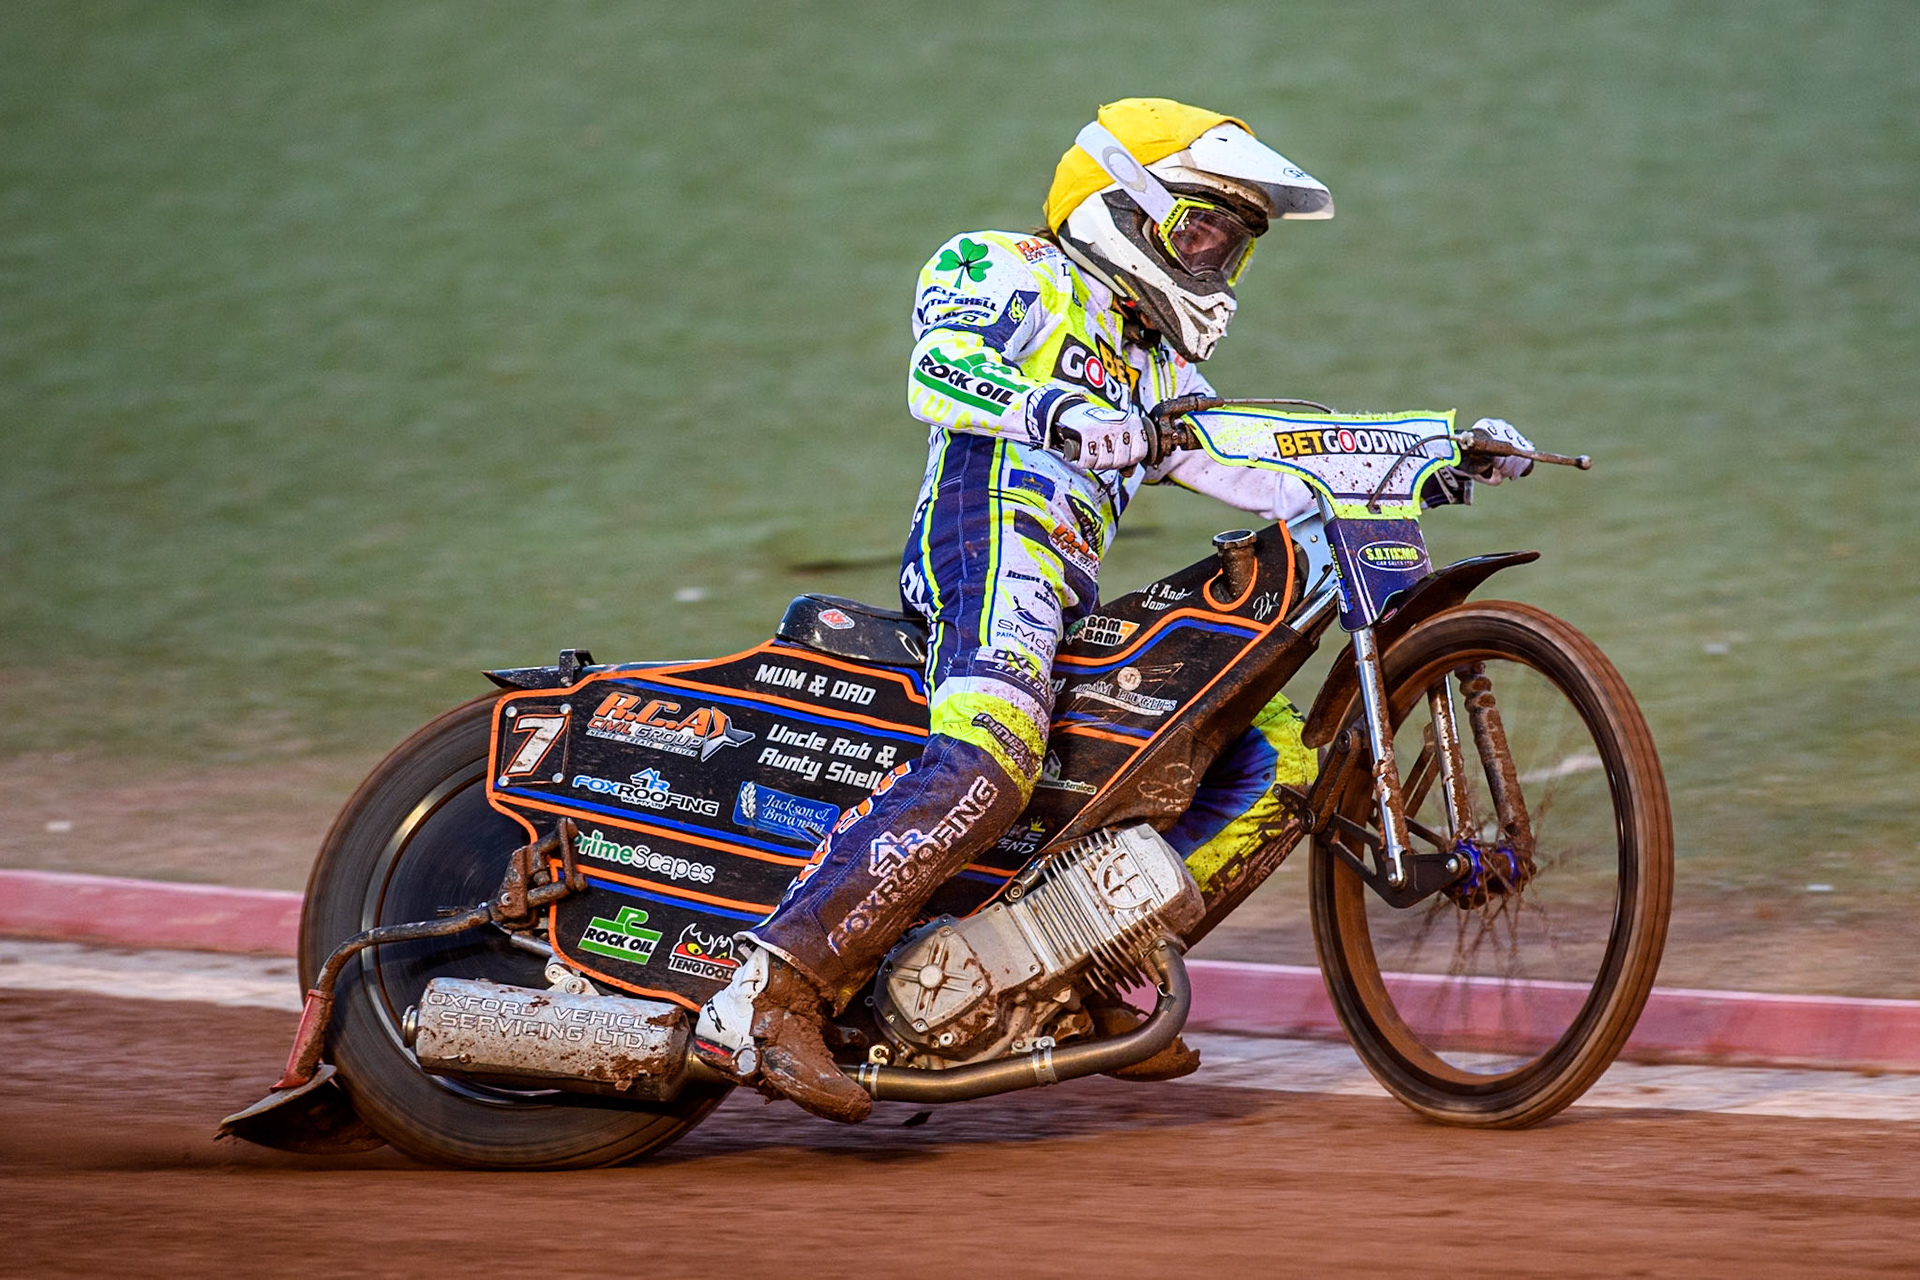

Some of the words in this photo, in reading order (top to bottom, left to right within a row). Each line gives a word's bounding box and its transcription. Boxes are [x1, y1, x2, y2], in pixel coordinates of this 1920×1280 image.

[918, 353, 974, 391] ROCK
[976, 381, 1014, 406] OIL
[1276, 430, 1428, 458] BETGOODWIN
[1084, 629, 1118, 645] BAM
[1086, 616, 1121, 631] BAM
[755, 664, 807, 690] MUM
[808, 674, 829, 698] &
[830, 682, 877, 706] DAD
[503, 713, 570, 777] 7
[588, 717, 632, 735] CIVIL
[636, 725, 704, 748] GROUP
[766, 723, 824, 752] Uncle
[829, 738, 873, 761] Rob
[875, 745, 897, 769] &
[757, 748, 823, 782] Aunty
[825, 762, 884, 790] Shell
[573, 775, 720, 816] FOXROOFING
[762, 793, 815, 818] Jackson
[585, 927, 629, 948] ROCK
[629, 937, 654, 953] OIL
[669, 955, 736, 982] TENGTOOL
[428, 992, 541, 1016] OXFORD
[440, 1011, 584, 1042] SERVICING
[595, 1028, 648, 1050] LTD.
